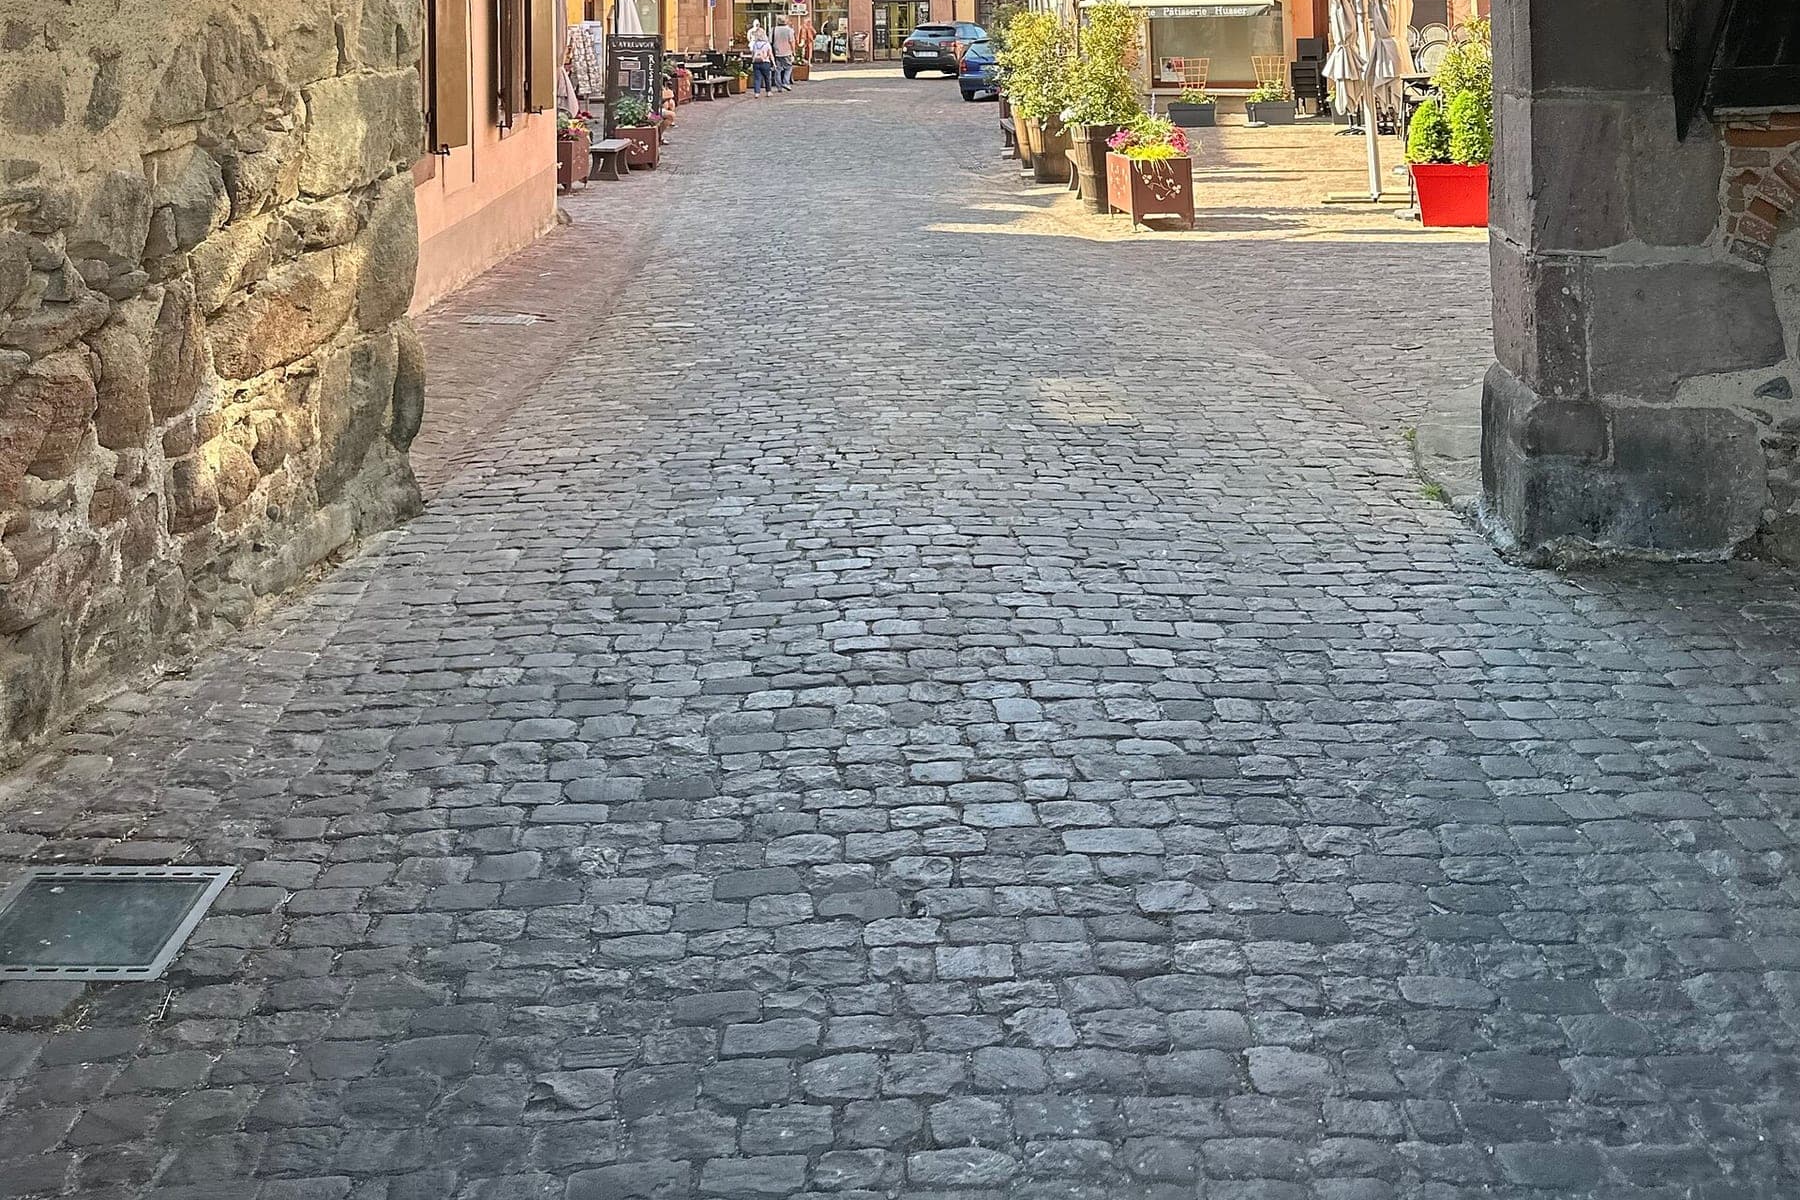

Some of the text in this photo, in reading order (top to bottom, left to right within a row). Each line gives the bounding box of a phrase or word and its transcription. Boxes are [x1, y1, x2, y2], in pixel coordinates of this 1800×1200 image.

[1163, 7, 1207, 16] Pâtisserie
[1214, 6, 1247, 15] Husser
[647, 54, 656, 112] RESTAUR
